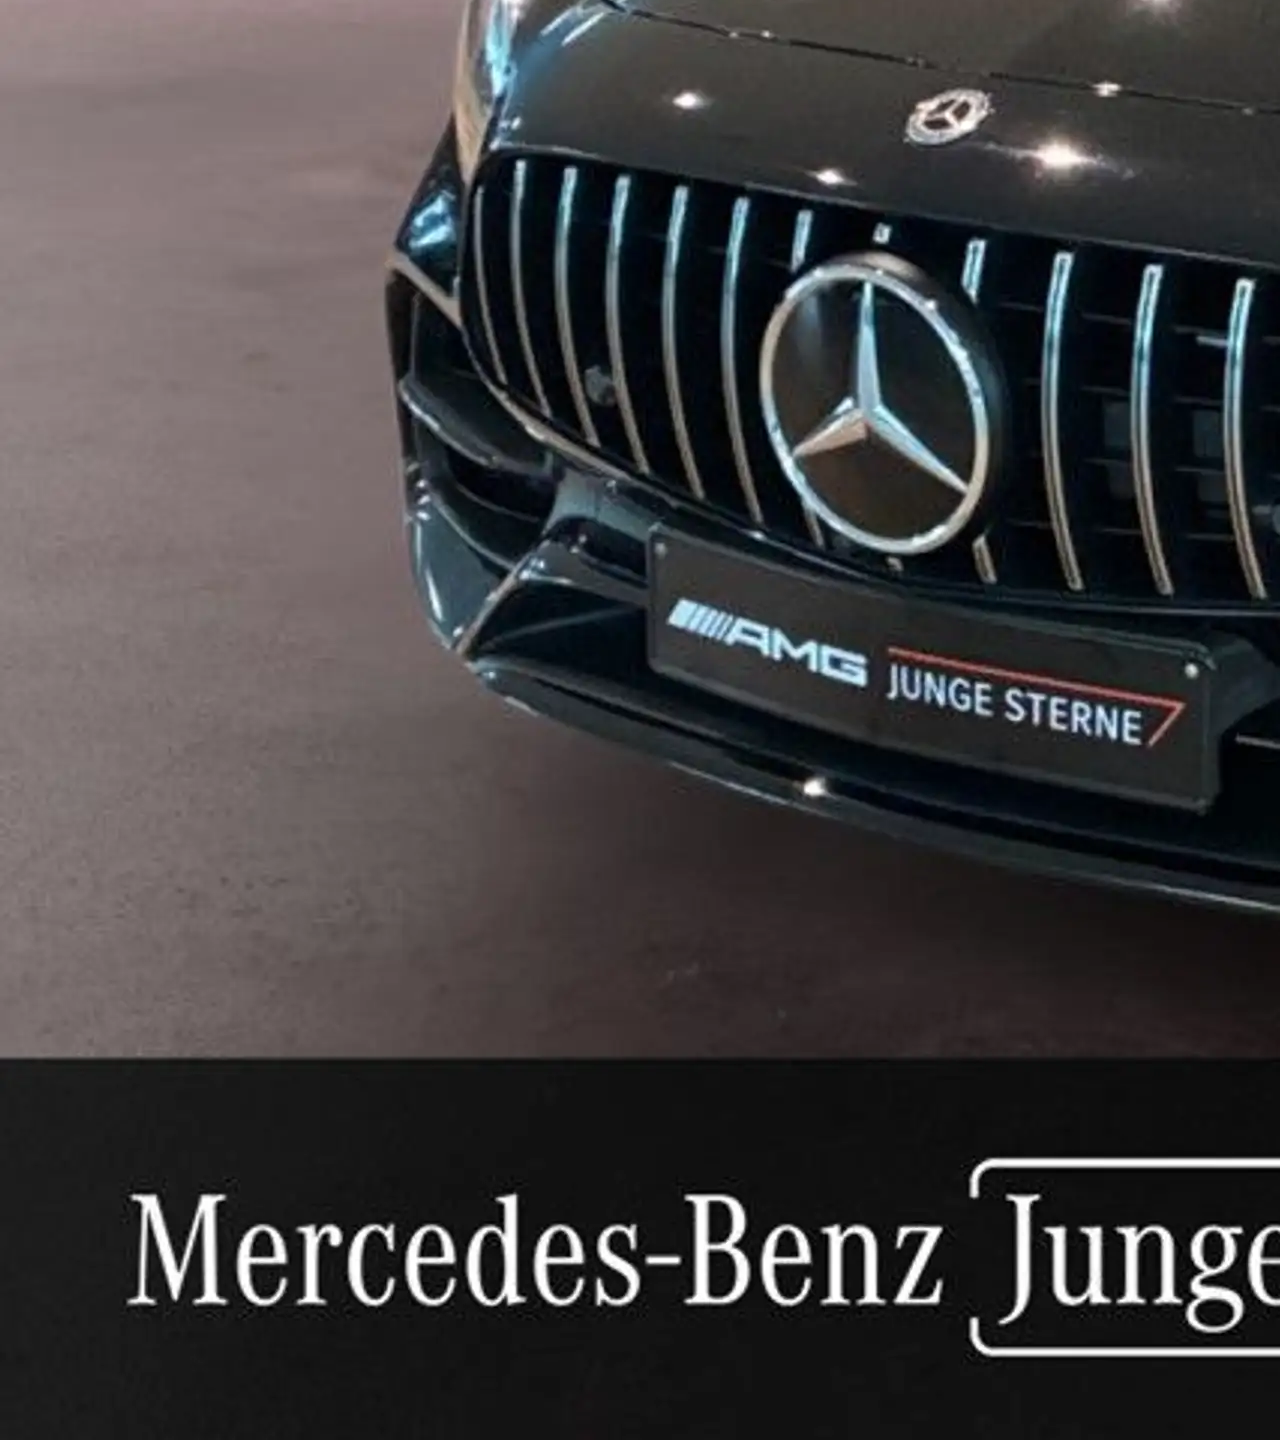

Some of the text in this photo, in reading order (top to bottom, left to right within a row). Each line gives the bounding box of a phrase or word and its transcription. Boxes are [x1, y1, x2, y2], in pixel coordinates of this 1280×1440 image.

[724, 616, 869, 688] AMG
[886, 661, 1143, 747] JUNGE STERNE
